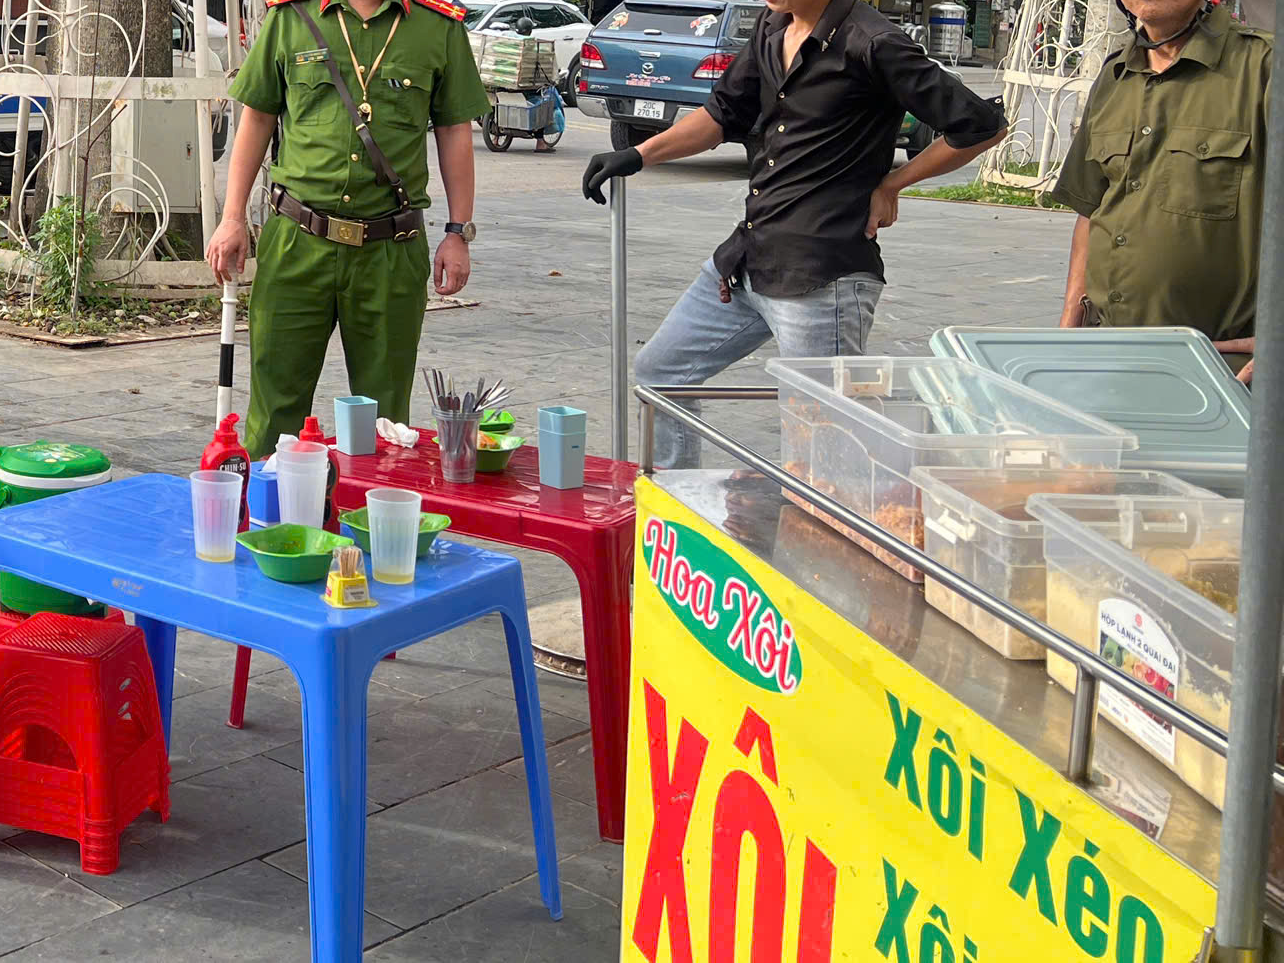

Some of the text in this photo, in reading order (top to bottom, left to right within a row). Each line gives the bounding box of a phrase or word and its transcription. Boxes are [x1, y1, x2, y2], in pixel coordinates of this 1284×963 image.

[637, 110, 661, 118] 270.15
[643, 101, 656, 110] 20C
[645, 517, 796, 692] Hoa Xôi
[884, 689, 1164, 963] Xôi Xéo
[874, 856, 978, 963] Xô
